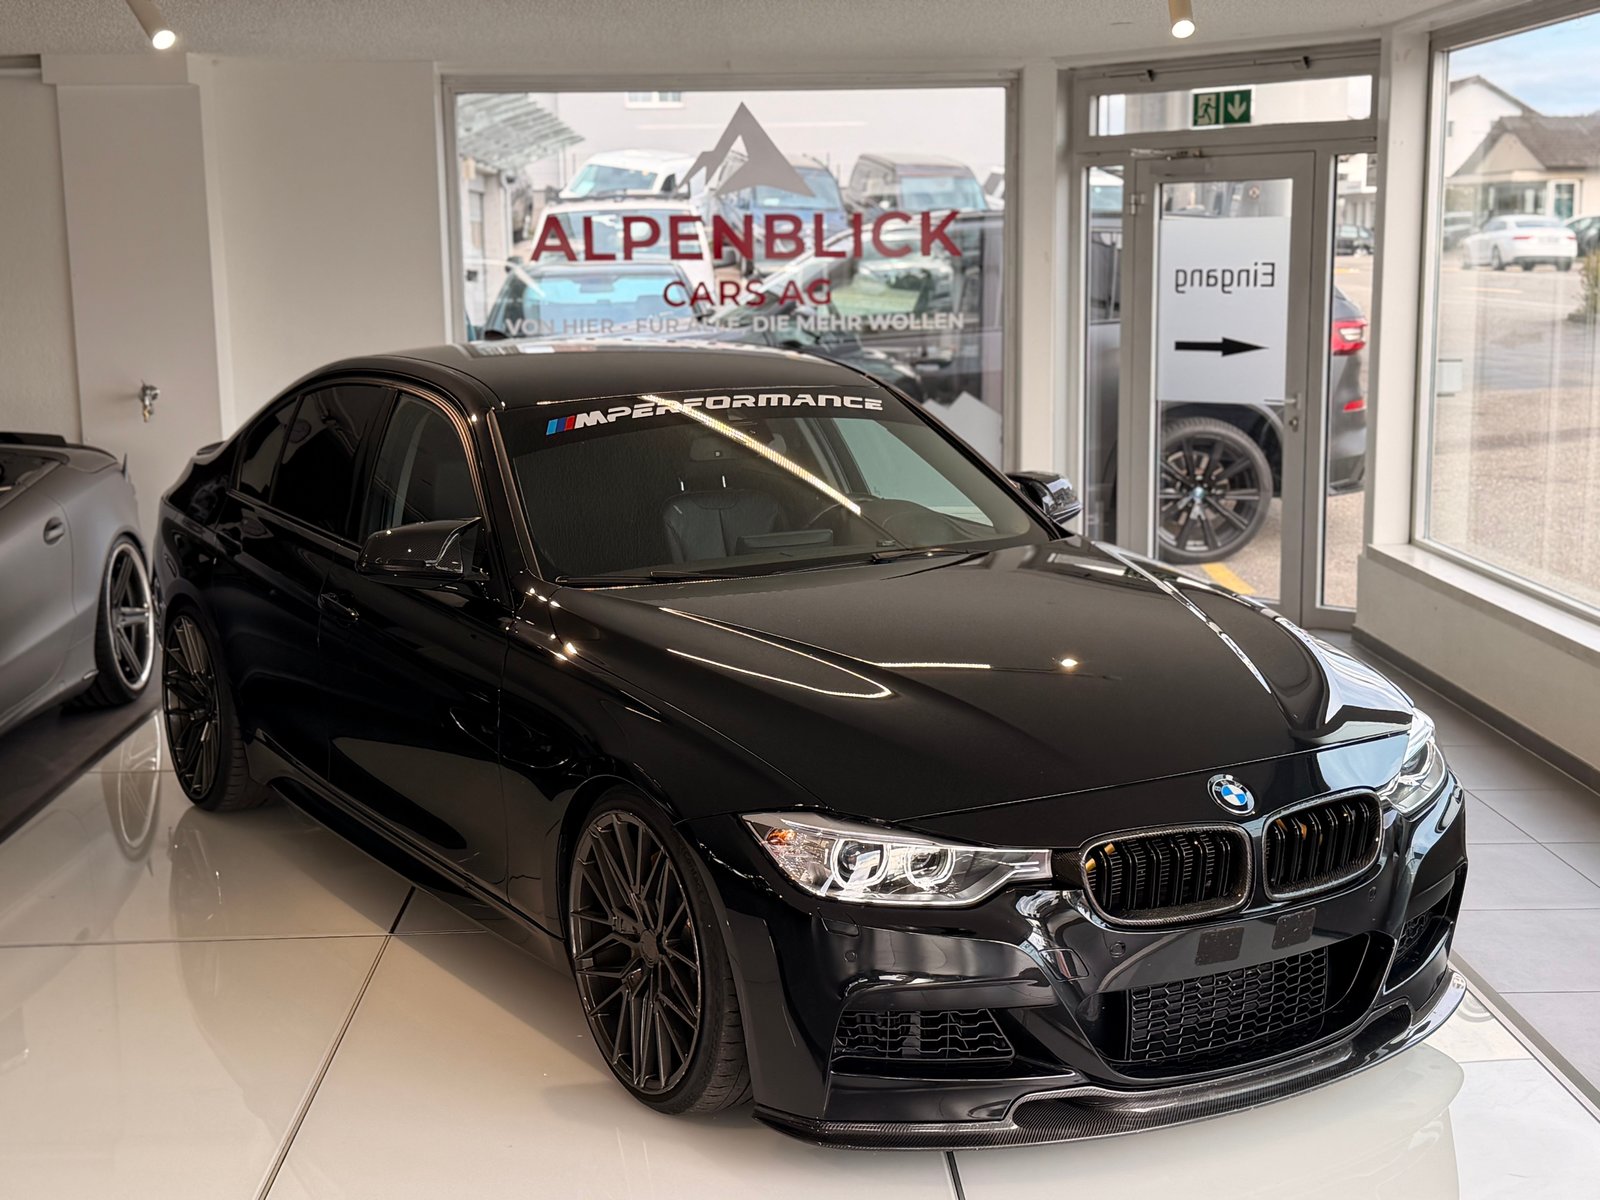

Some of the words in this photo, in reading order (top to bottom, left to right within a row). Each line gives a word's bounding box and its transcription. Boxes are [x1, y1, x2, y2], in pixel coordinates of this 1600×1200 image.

[530, 208, 962, 262] ALPENBLICK
[662, 279, 766, 308] CARS
[776, 278, 832, 307] AG
[505, 317, 555, 336] VON
[562, 317, 615, 335] HIER
[636, 314, 680, 334] FÜR
[752, 315, 790, 332] DIE
[797, 314, 863, 332] MEHR
[867, 312, 965, 331] WOLLEN
